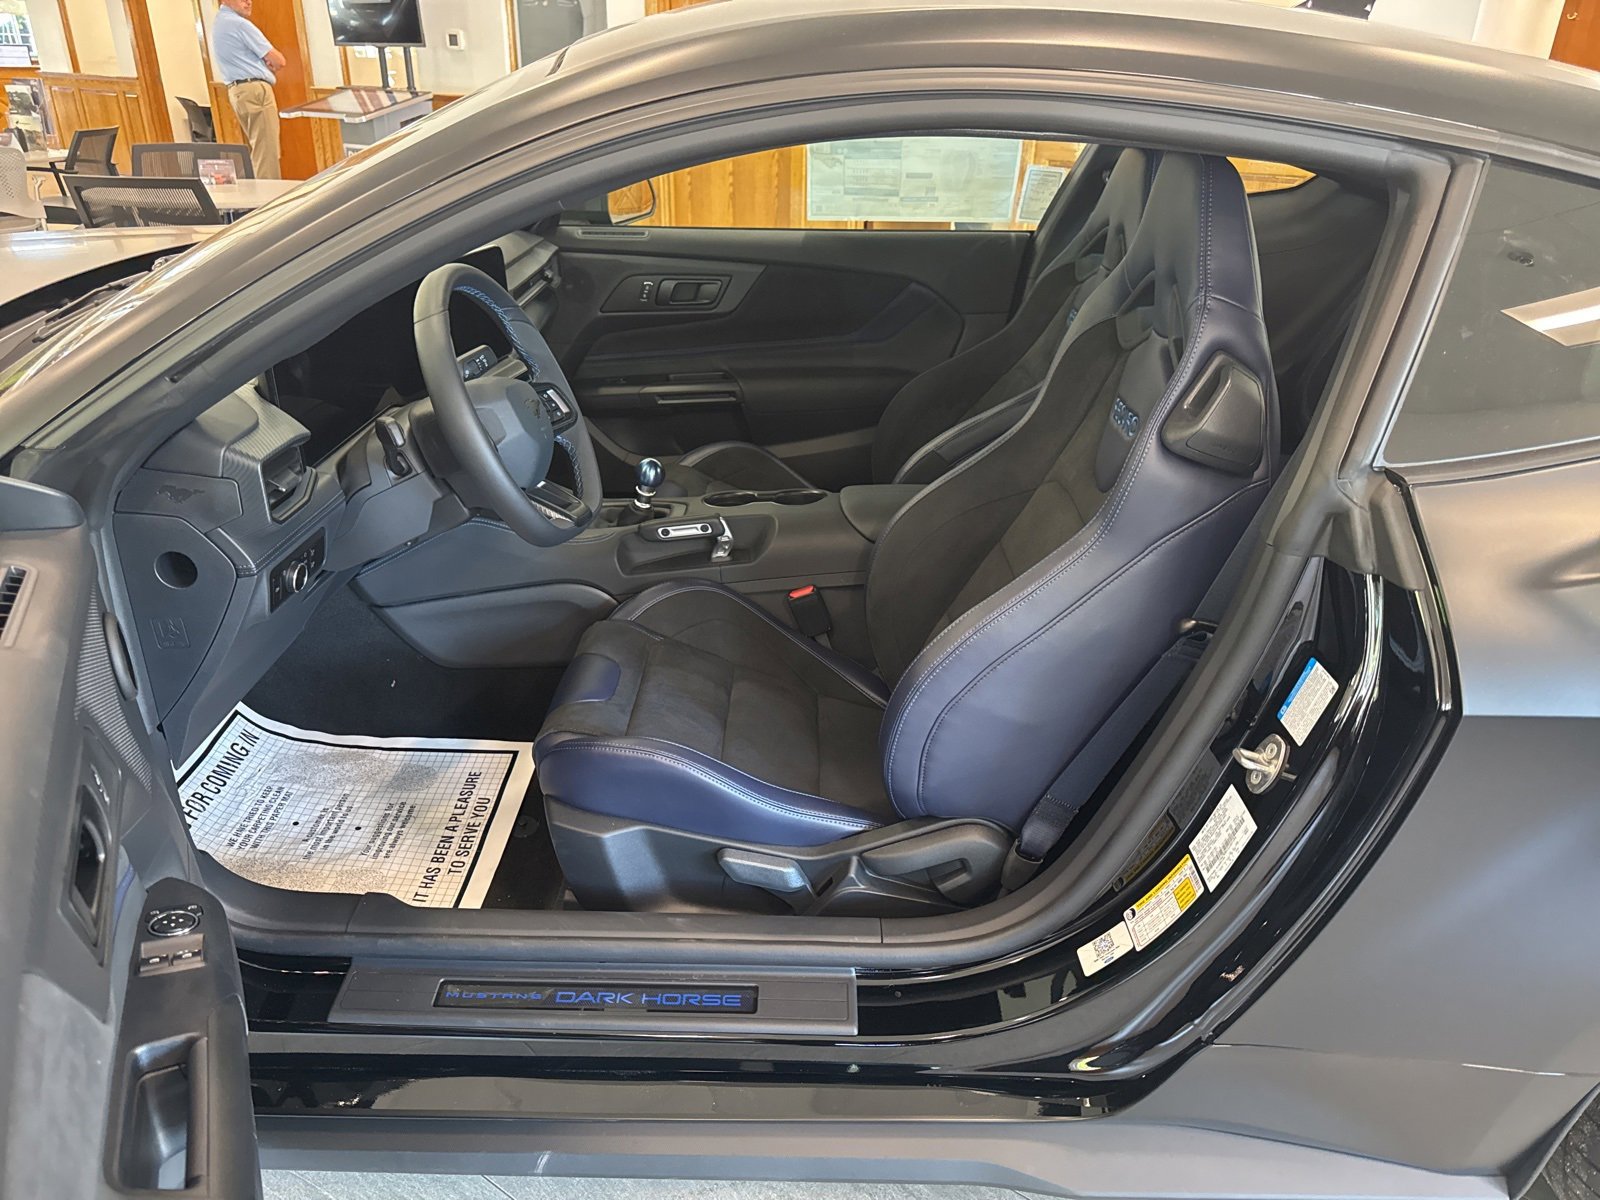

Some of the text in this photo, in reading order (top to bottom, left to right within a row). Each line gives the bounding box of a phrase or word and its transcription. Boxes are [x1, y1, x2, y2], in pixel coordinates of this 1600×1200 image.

[183, 728, 260, 821] FOR COMING IN
[226, 785, 273, 847] WE HAVE TRIED TO KEEP
[236, 786, 285, 850] YOUR CARPETING CLEAN
[250, 790, 294, 849] WITH THIS PAPER MAT
[302, 793, 351, 860] the most important person
[306, 814, 325, 838] customer
[361, 802, 395, 856] Your suggestions for
[371, 801, 407, 860] improving our service
[383, 850, 393, 859] are
[389, 830, 404, 848] always
[412, 771, 482, 903] IT HAS BEEN A PLEASURE
[447, 797, 491, 875] TO SERVE YOU
[445, 990, 742, 1007] MUSTANG DARK HORSE
